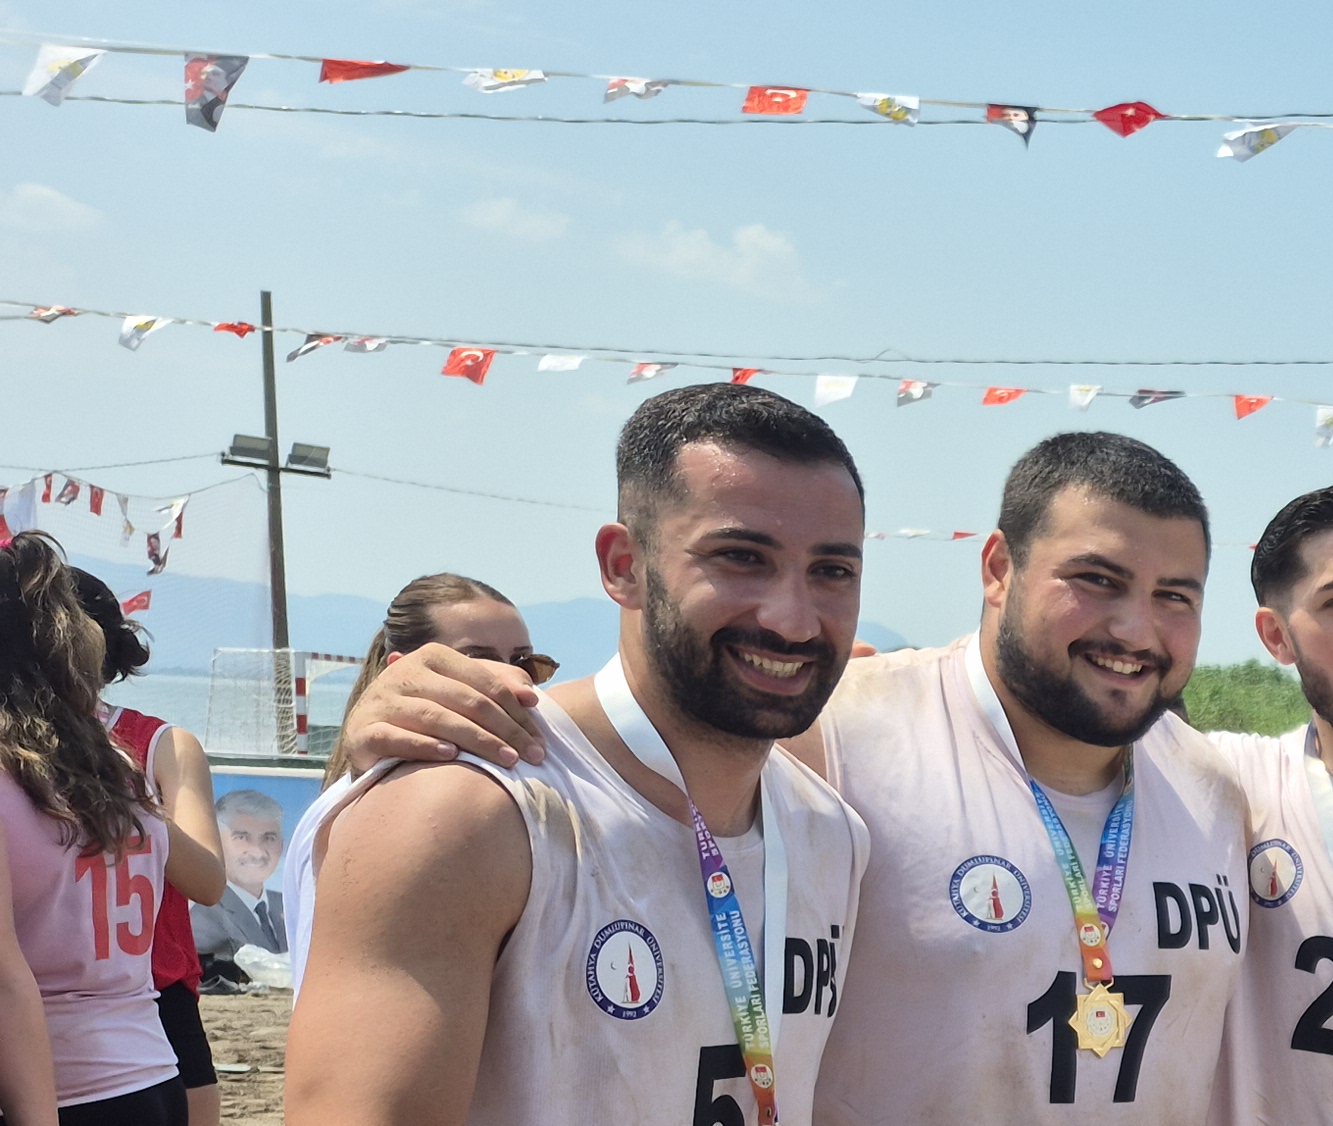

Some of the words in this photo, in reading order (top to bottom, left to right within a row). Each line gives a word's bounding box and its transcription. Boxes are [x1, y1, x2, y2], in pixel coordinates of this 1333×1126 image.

[75, 835, 155, 962] 15
[1108, 864, 1127, 912] SPORLARI
[1153, 874, 1241, 954] DPÜ
[716, 912, 744, 989] ÜNİVERSİTE
[730, 909, 760, 992] FEDERASYONU
[751, 994, 770, 1048] SPORLARI
[1027, 971, 1172, 1104] 17
